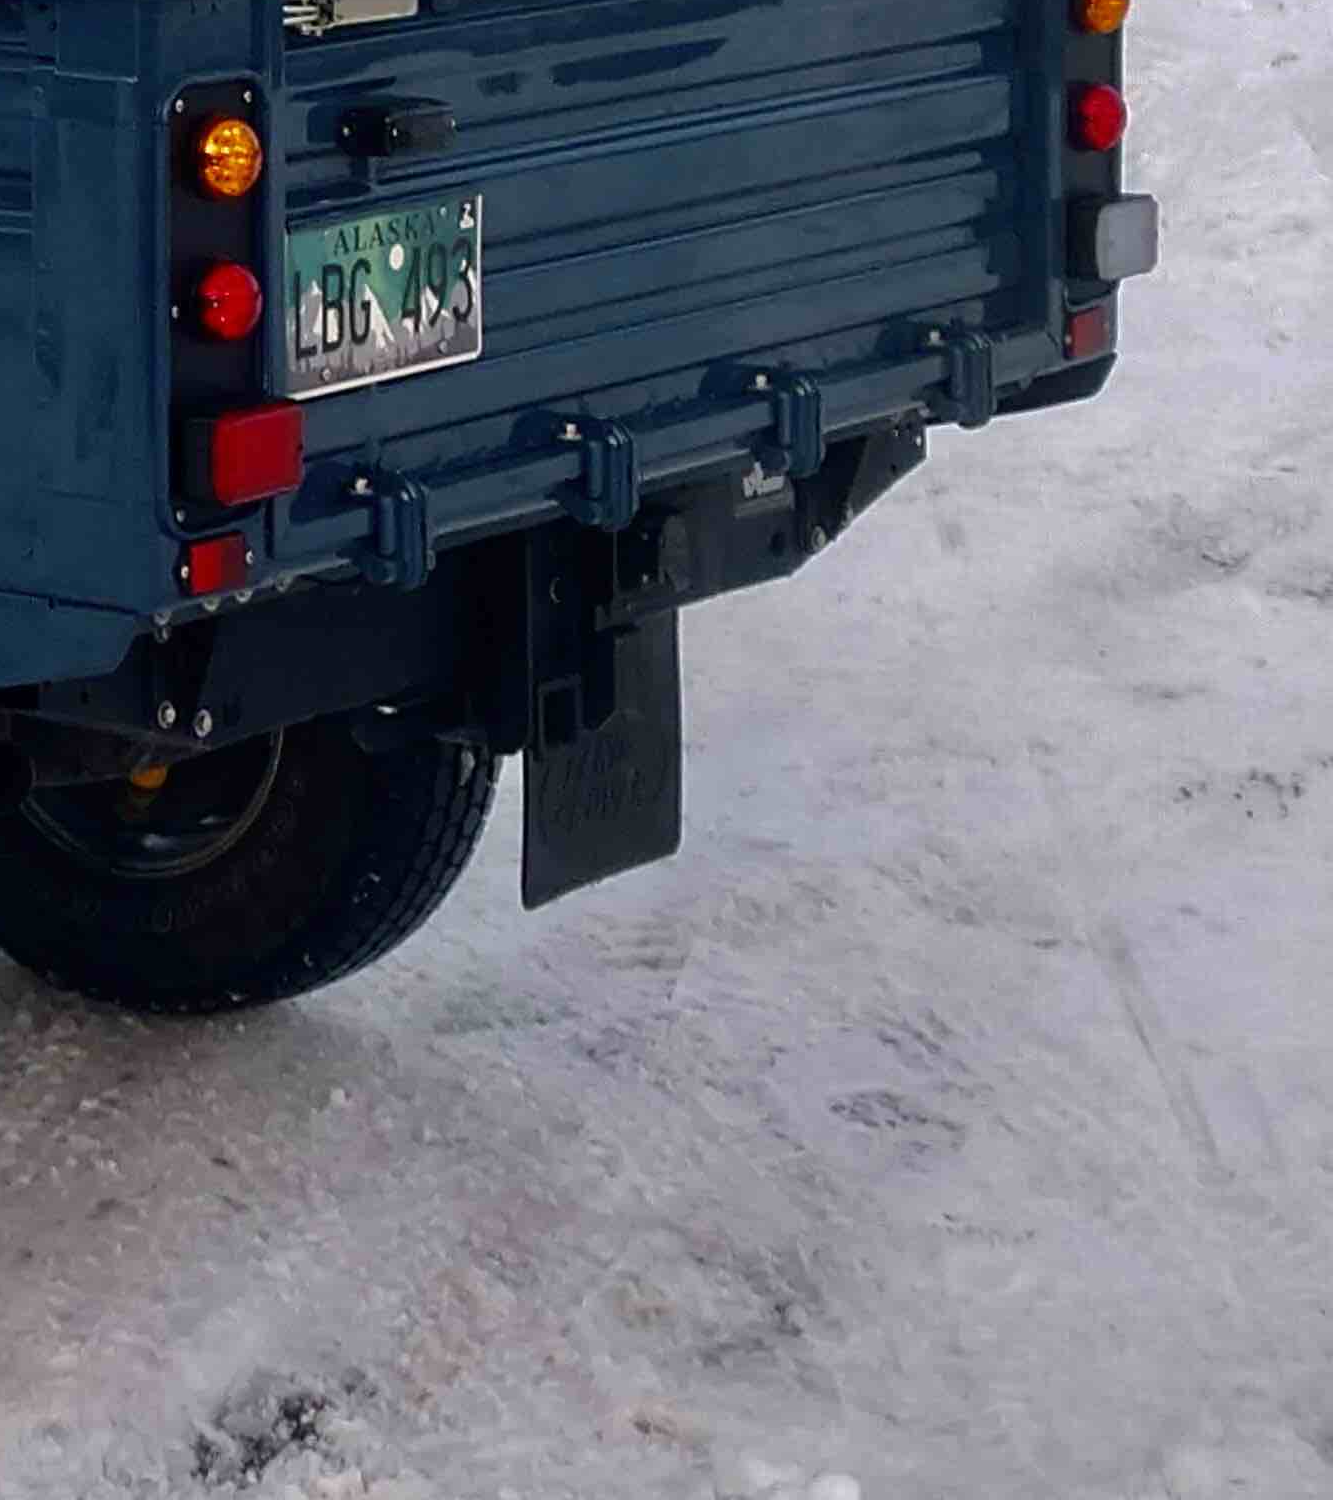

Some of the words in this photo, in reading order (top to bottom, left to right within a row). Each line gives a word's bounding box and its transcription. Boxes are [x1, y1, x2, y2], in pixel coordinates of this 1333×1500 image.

[333, 212, 435, 256] ALASKA
[294, 257, 373, 360] LBG
[400, 237, 474, 332] 493
